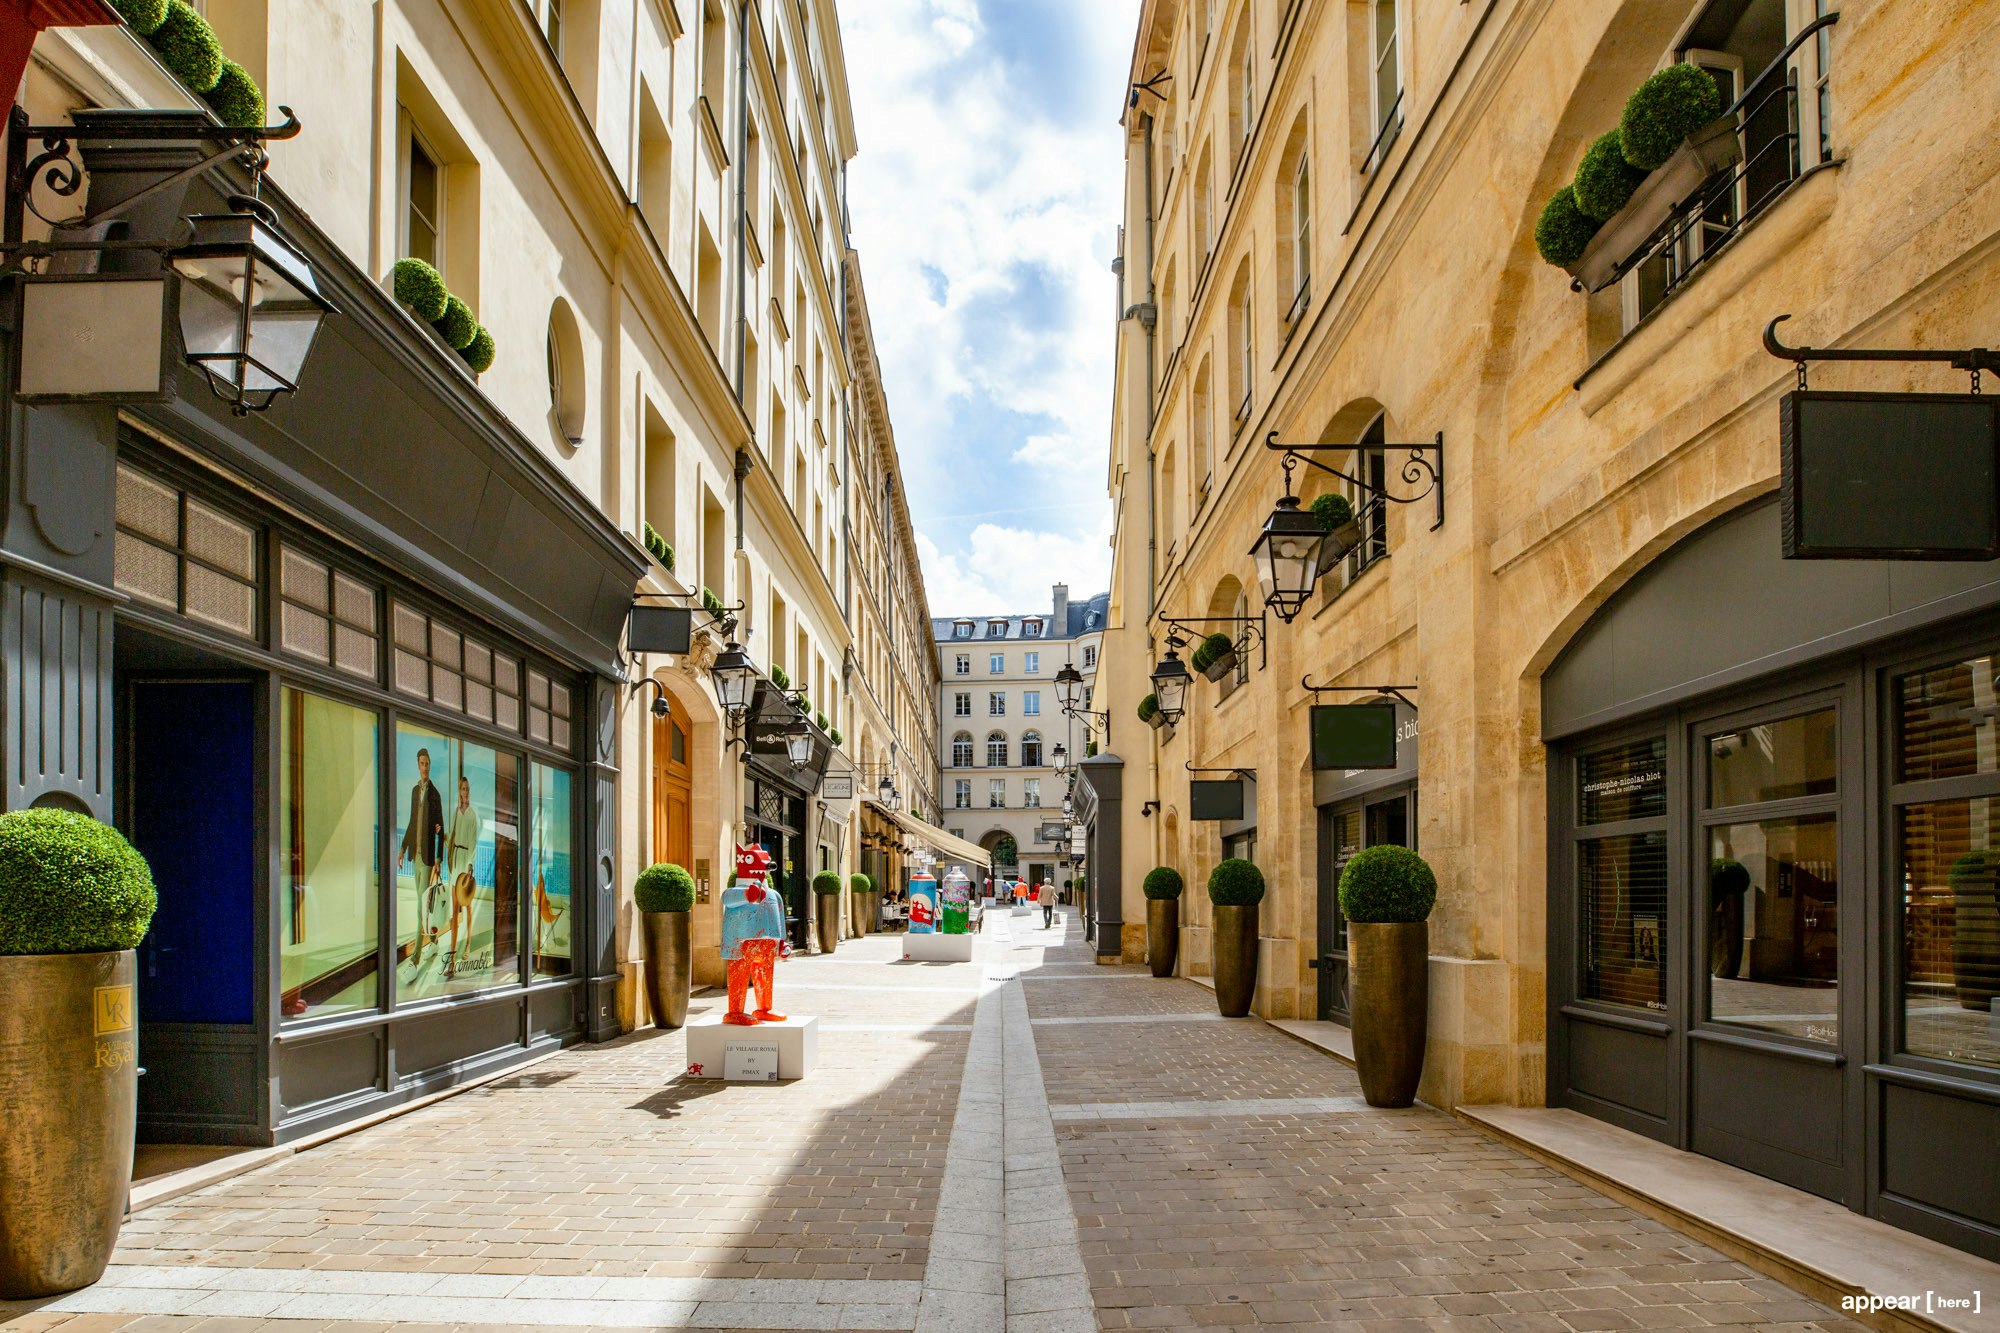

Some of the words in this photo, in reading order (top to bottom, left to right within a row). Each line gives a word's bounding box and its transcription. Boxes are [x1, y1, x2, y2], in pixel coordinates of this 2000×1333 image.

[1584, 775, 1645, 792] christophe-nicolas
[1646, 771, 1661, 781] biot
[1600, 788, 1616, 796] maison
